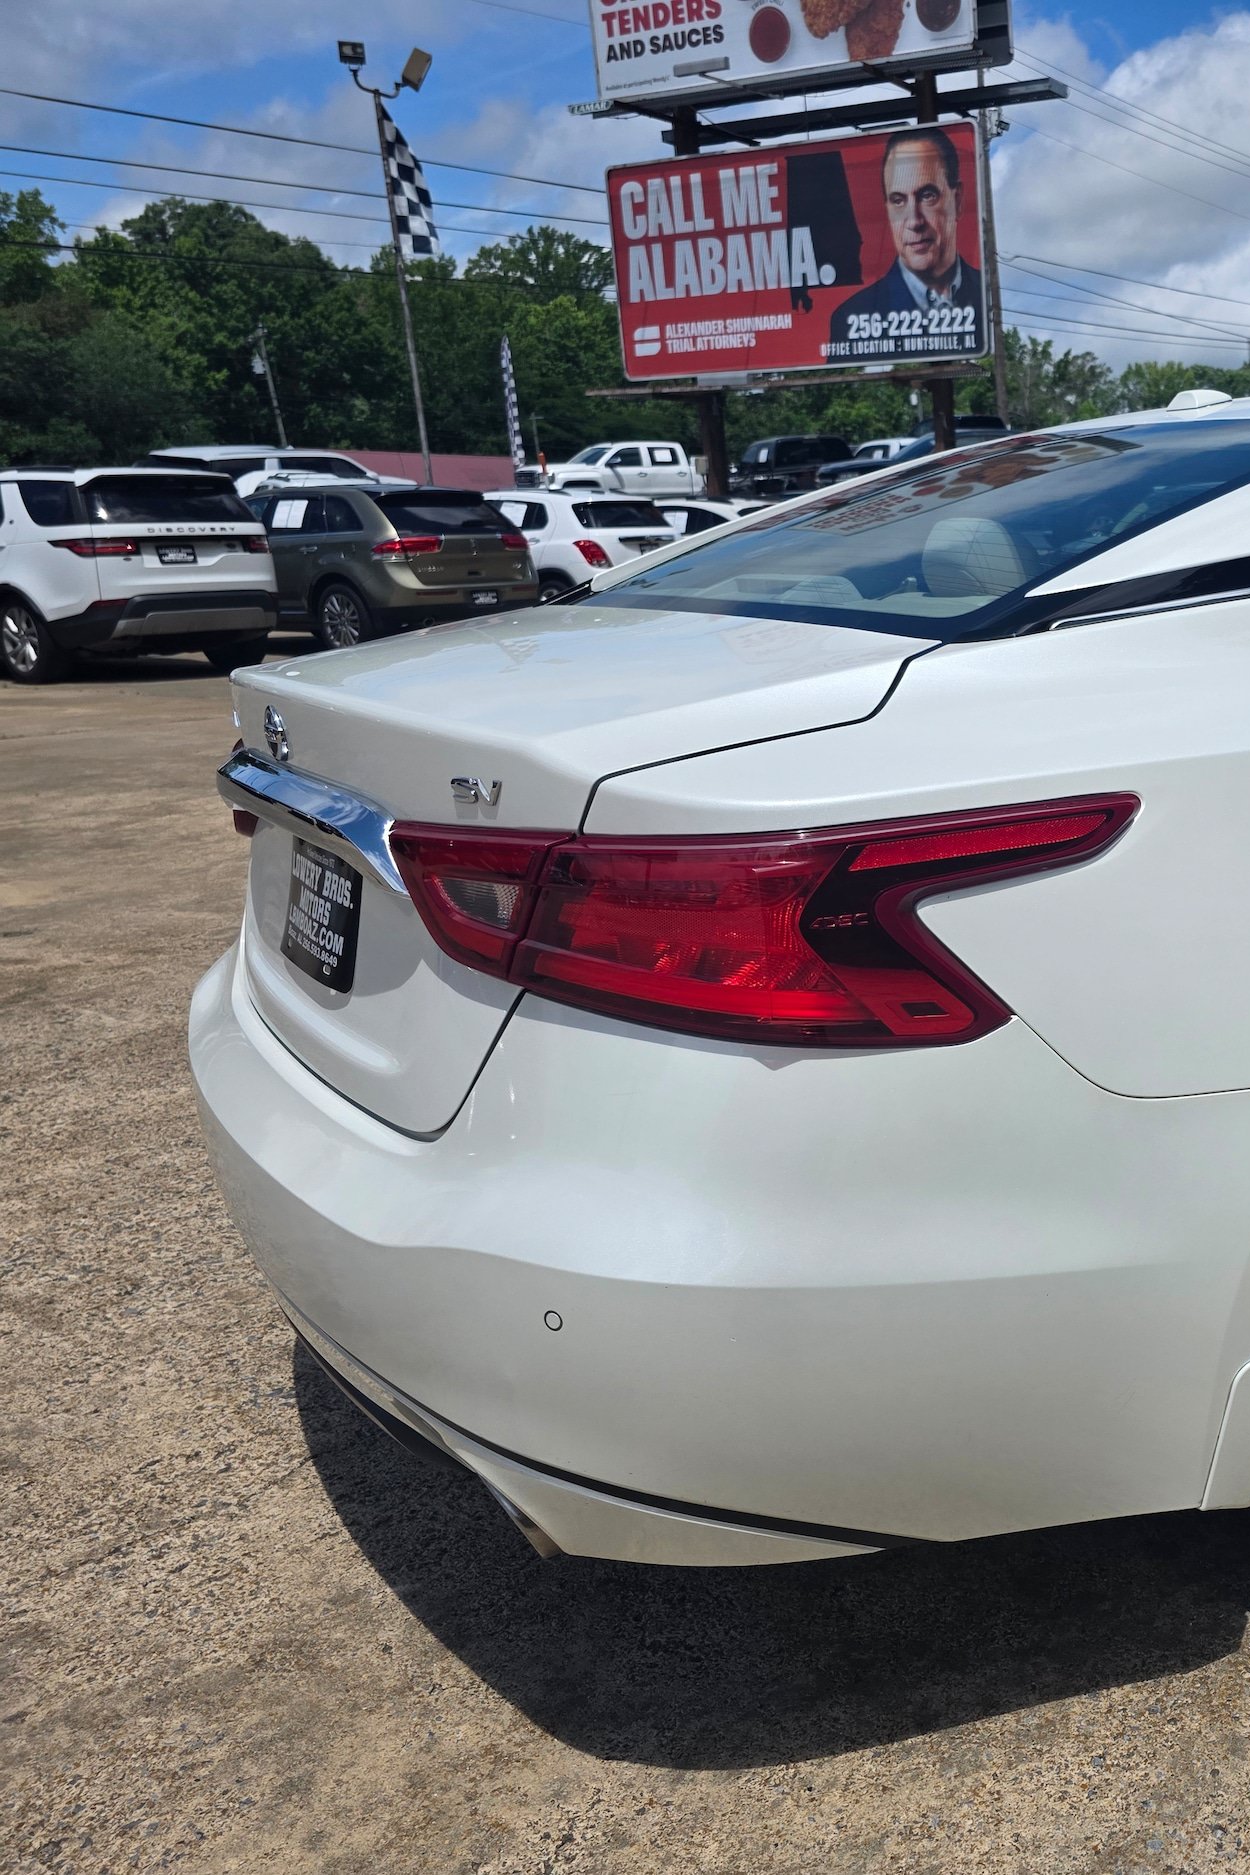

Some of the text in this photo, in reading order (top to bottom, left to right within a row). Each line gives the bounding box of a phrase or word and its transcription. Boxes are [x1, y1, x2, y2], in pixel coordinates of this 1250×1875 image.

[602, 0, 723, 38] TENDERS
[606, 24, 725, 63] AND SAUCES
[620, 162, 783, 240] CALL ME
[629, 226, 837, 303] ALABAMA.
[665, 314, 792, 339] ALEXANDER SHUNNARAH
[847, 307, 976, 339] 256-222-2222
[666, 332, 757, 354] TRIAL ATTORNEYS
[820, 342, 851, 357] OFFICE
[853, 339, 895, 354] LOCATION
[904, 335, 962, 351] HUNTSVILLE,
[965, 334, 976, 348] AL
[147, 526, 236, 534] DISCOVERY
[451, 778, 502, 806] SV
[292, 851, 323, 892] LOWERY
[322, 870, 354, 910] BROS.
[299, 885, 332, 926] MOTORS
